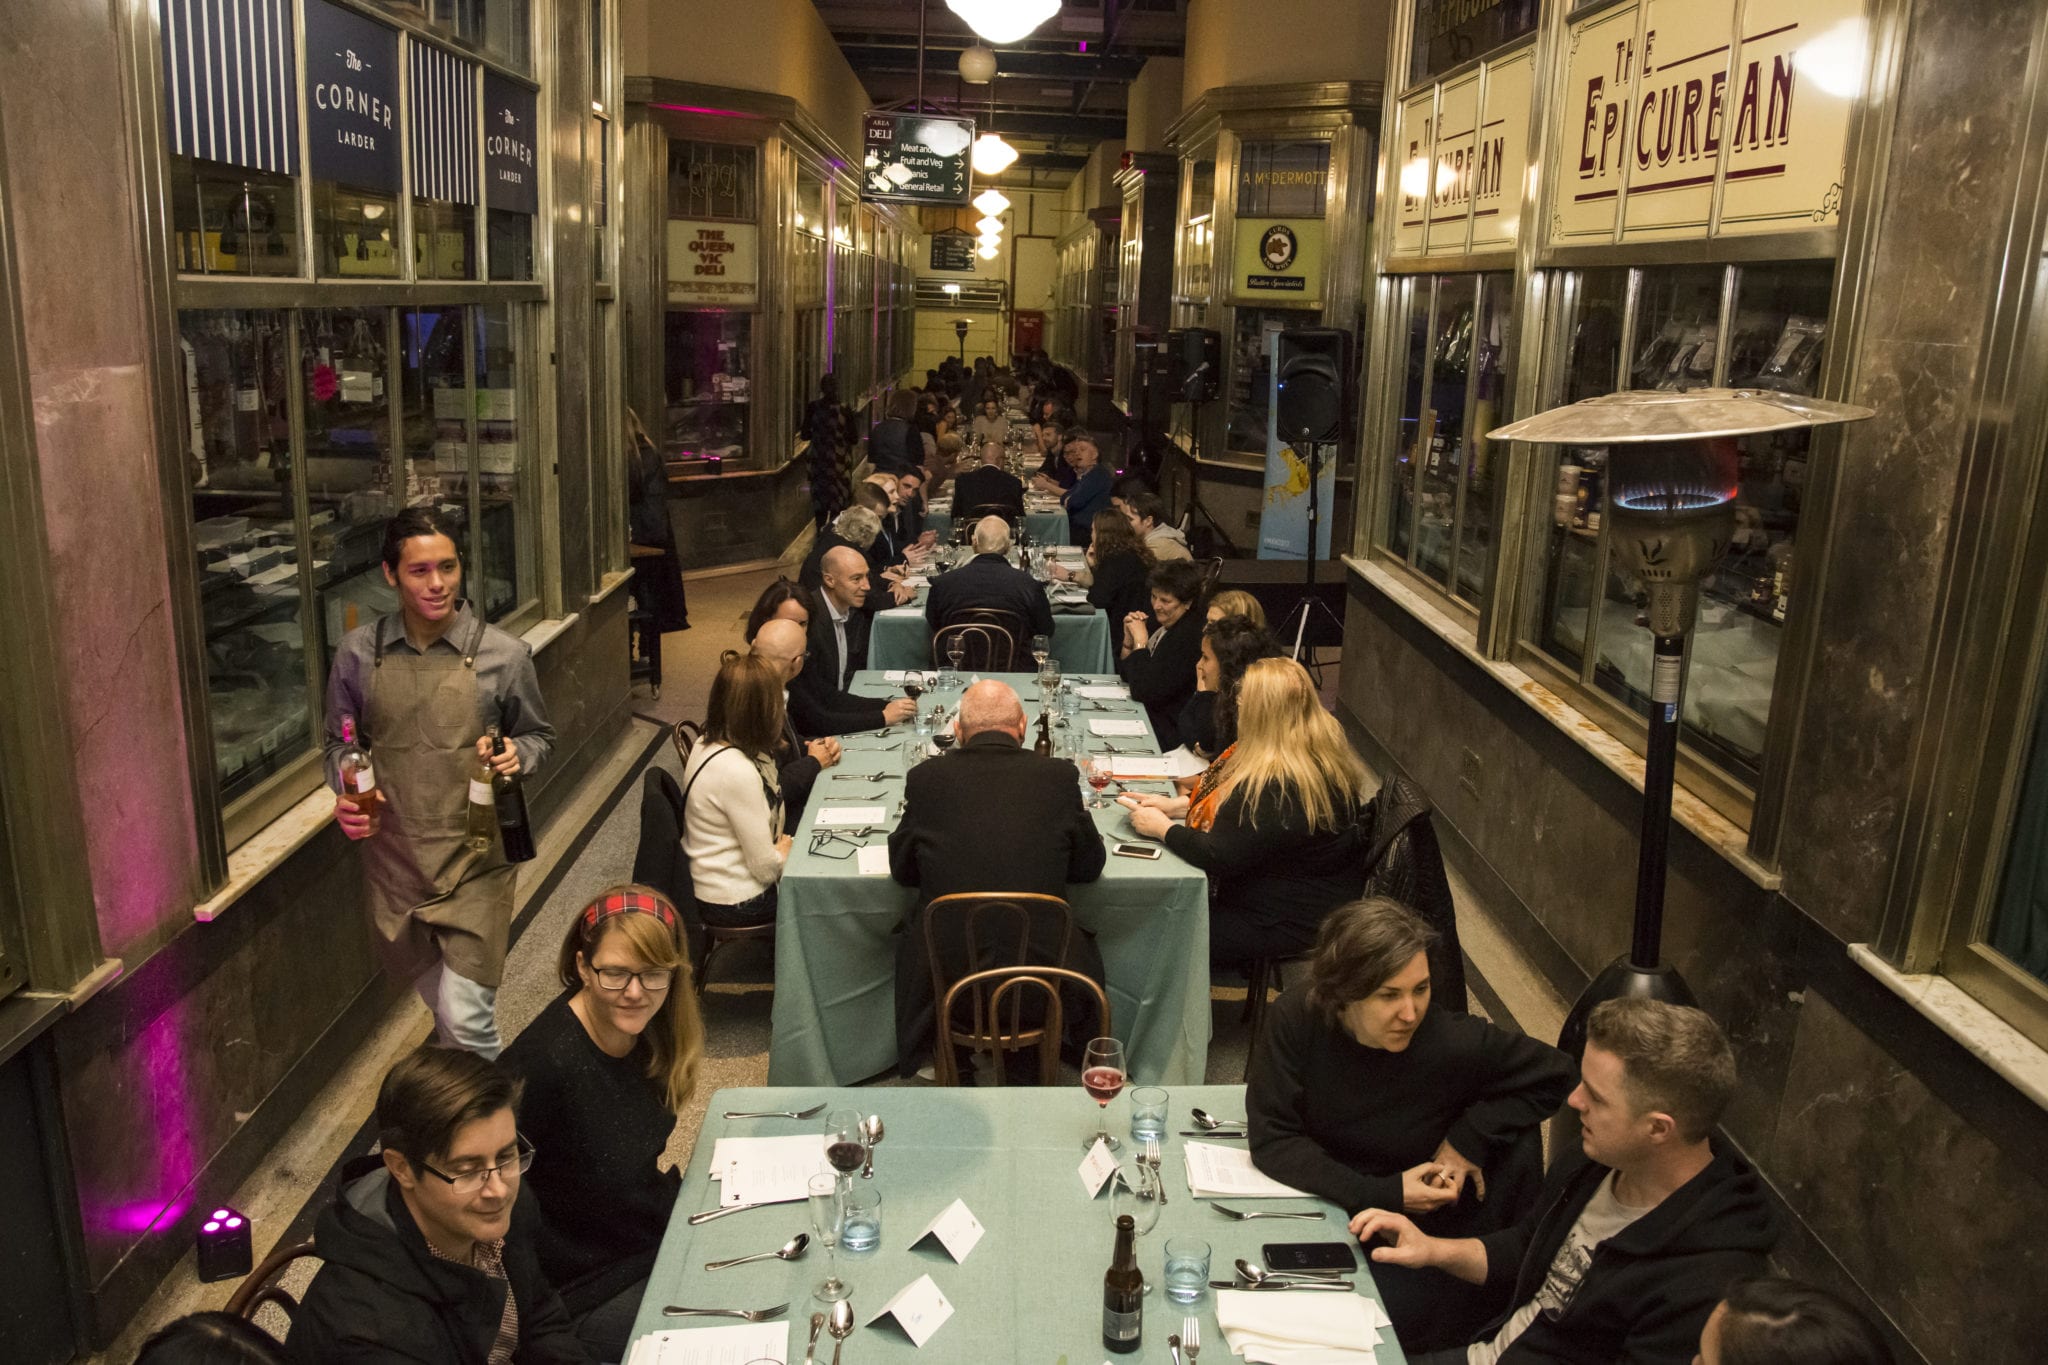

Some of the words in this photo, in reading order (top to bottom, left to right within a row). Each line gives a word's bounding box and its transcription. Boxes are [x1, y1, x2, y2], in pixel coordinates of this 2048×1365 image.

[346, 49, 362, 72] The
[1615, 30, 1655, 86] THE
[315, 83, 391, 130] CORNER
[1579, 51, 1797, 180] EPICUREAN
[338, 129, 375, 151] LARDER
[869, 128, 892, 139] DELI
[487, 135, 532, 168] CORNER
[901, 143, 918, 153] Meat
[900, 155, 917, 165] Fruit
[917, 157, 929, 166] and
[930, 158, 943, 169] Veg
[499, 168, 522, 184] LARDER
[899, 181, 925, 191] General
[925, 183, 944, 192] Retail
[696, 229, 725, 241] THE
[688, 241, 734, 253] QUEEN
[694, 264, 725, 276] DELI
